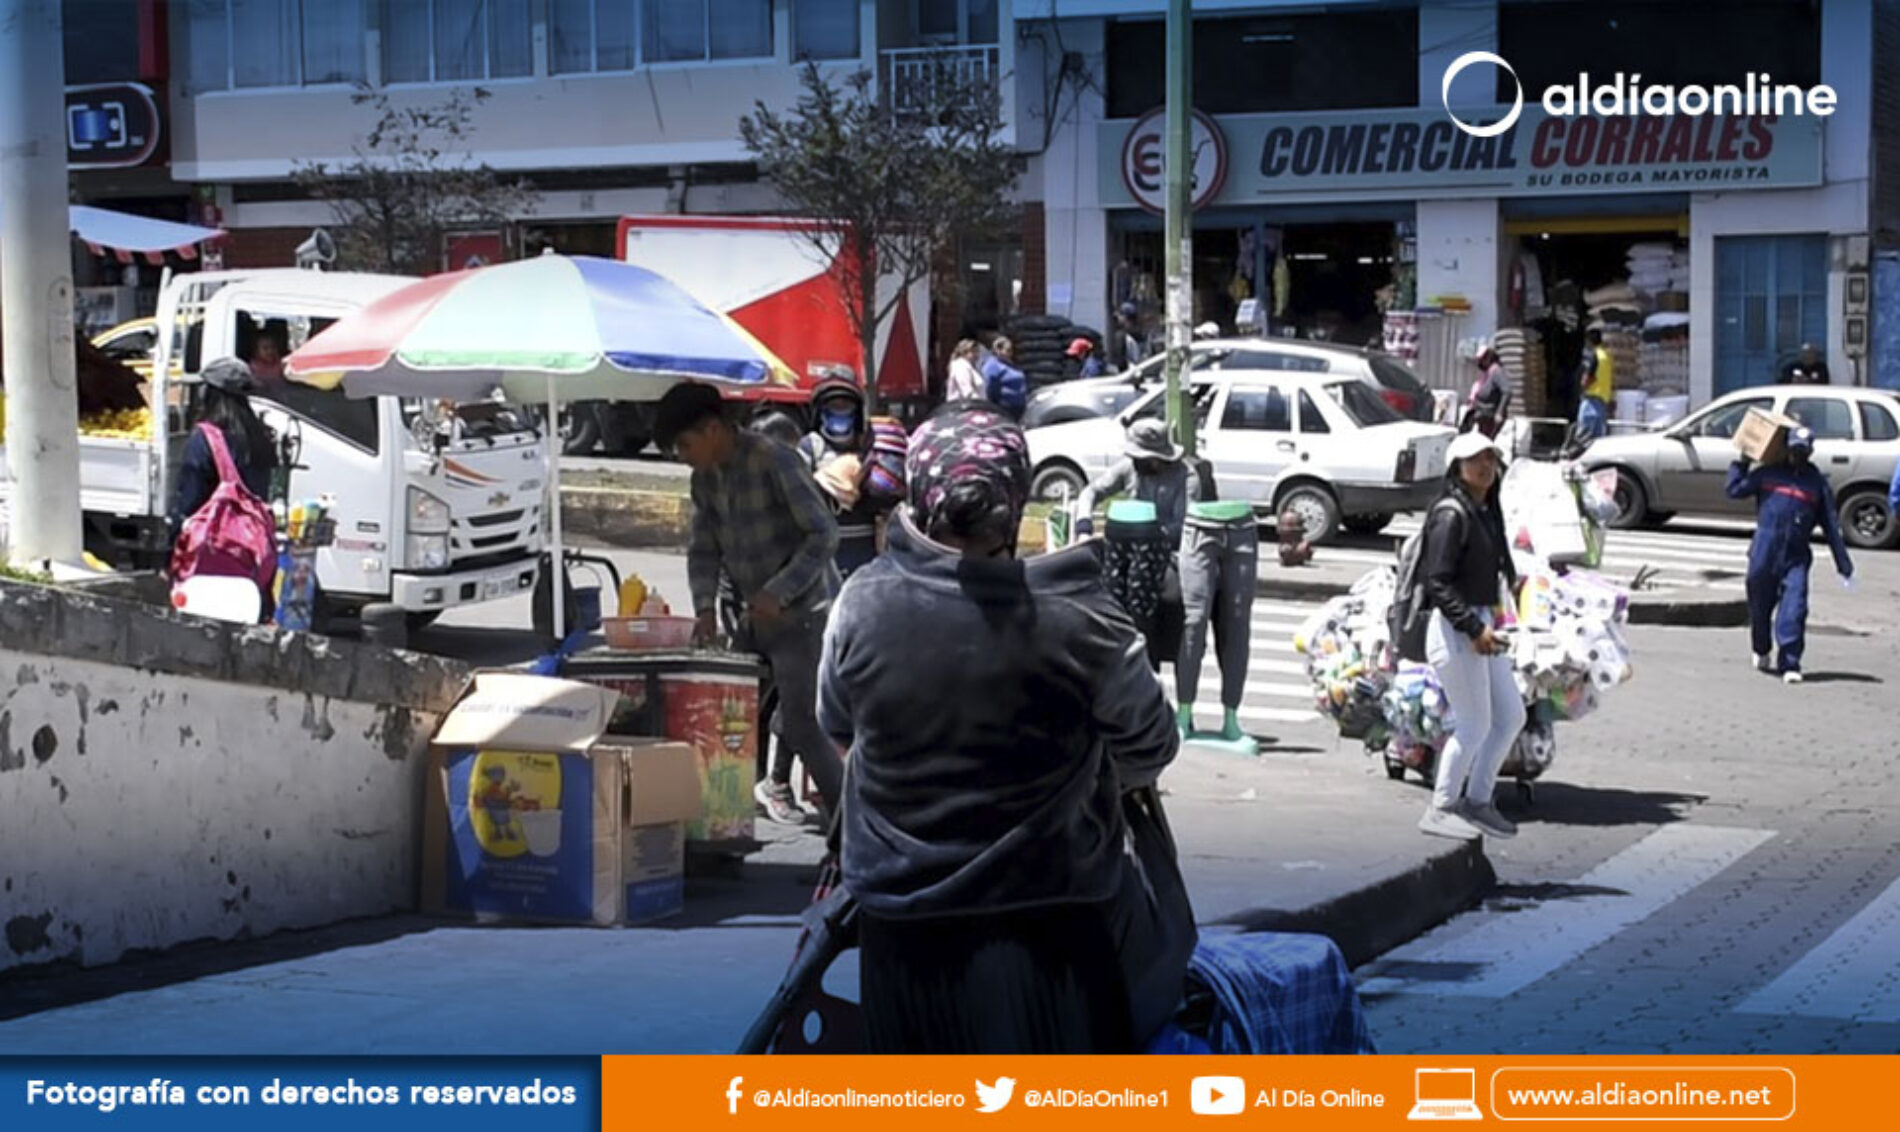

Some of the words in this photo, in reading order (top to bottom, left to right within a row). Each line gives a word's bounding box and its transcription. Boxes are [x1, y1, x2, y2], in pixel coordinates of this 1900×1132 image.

[1260, 117, 1518, 177] COMERCIAL
[1530, 113, 1777, 168] CORRALES
[1526, 174, 1553, 187] SU
[1561, 170, 1644, 185] BODEGA
[1652, 165, 1771, 183] MAYORISTA
